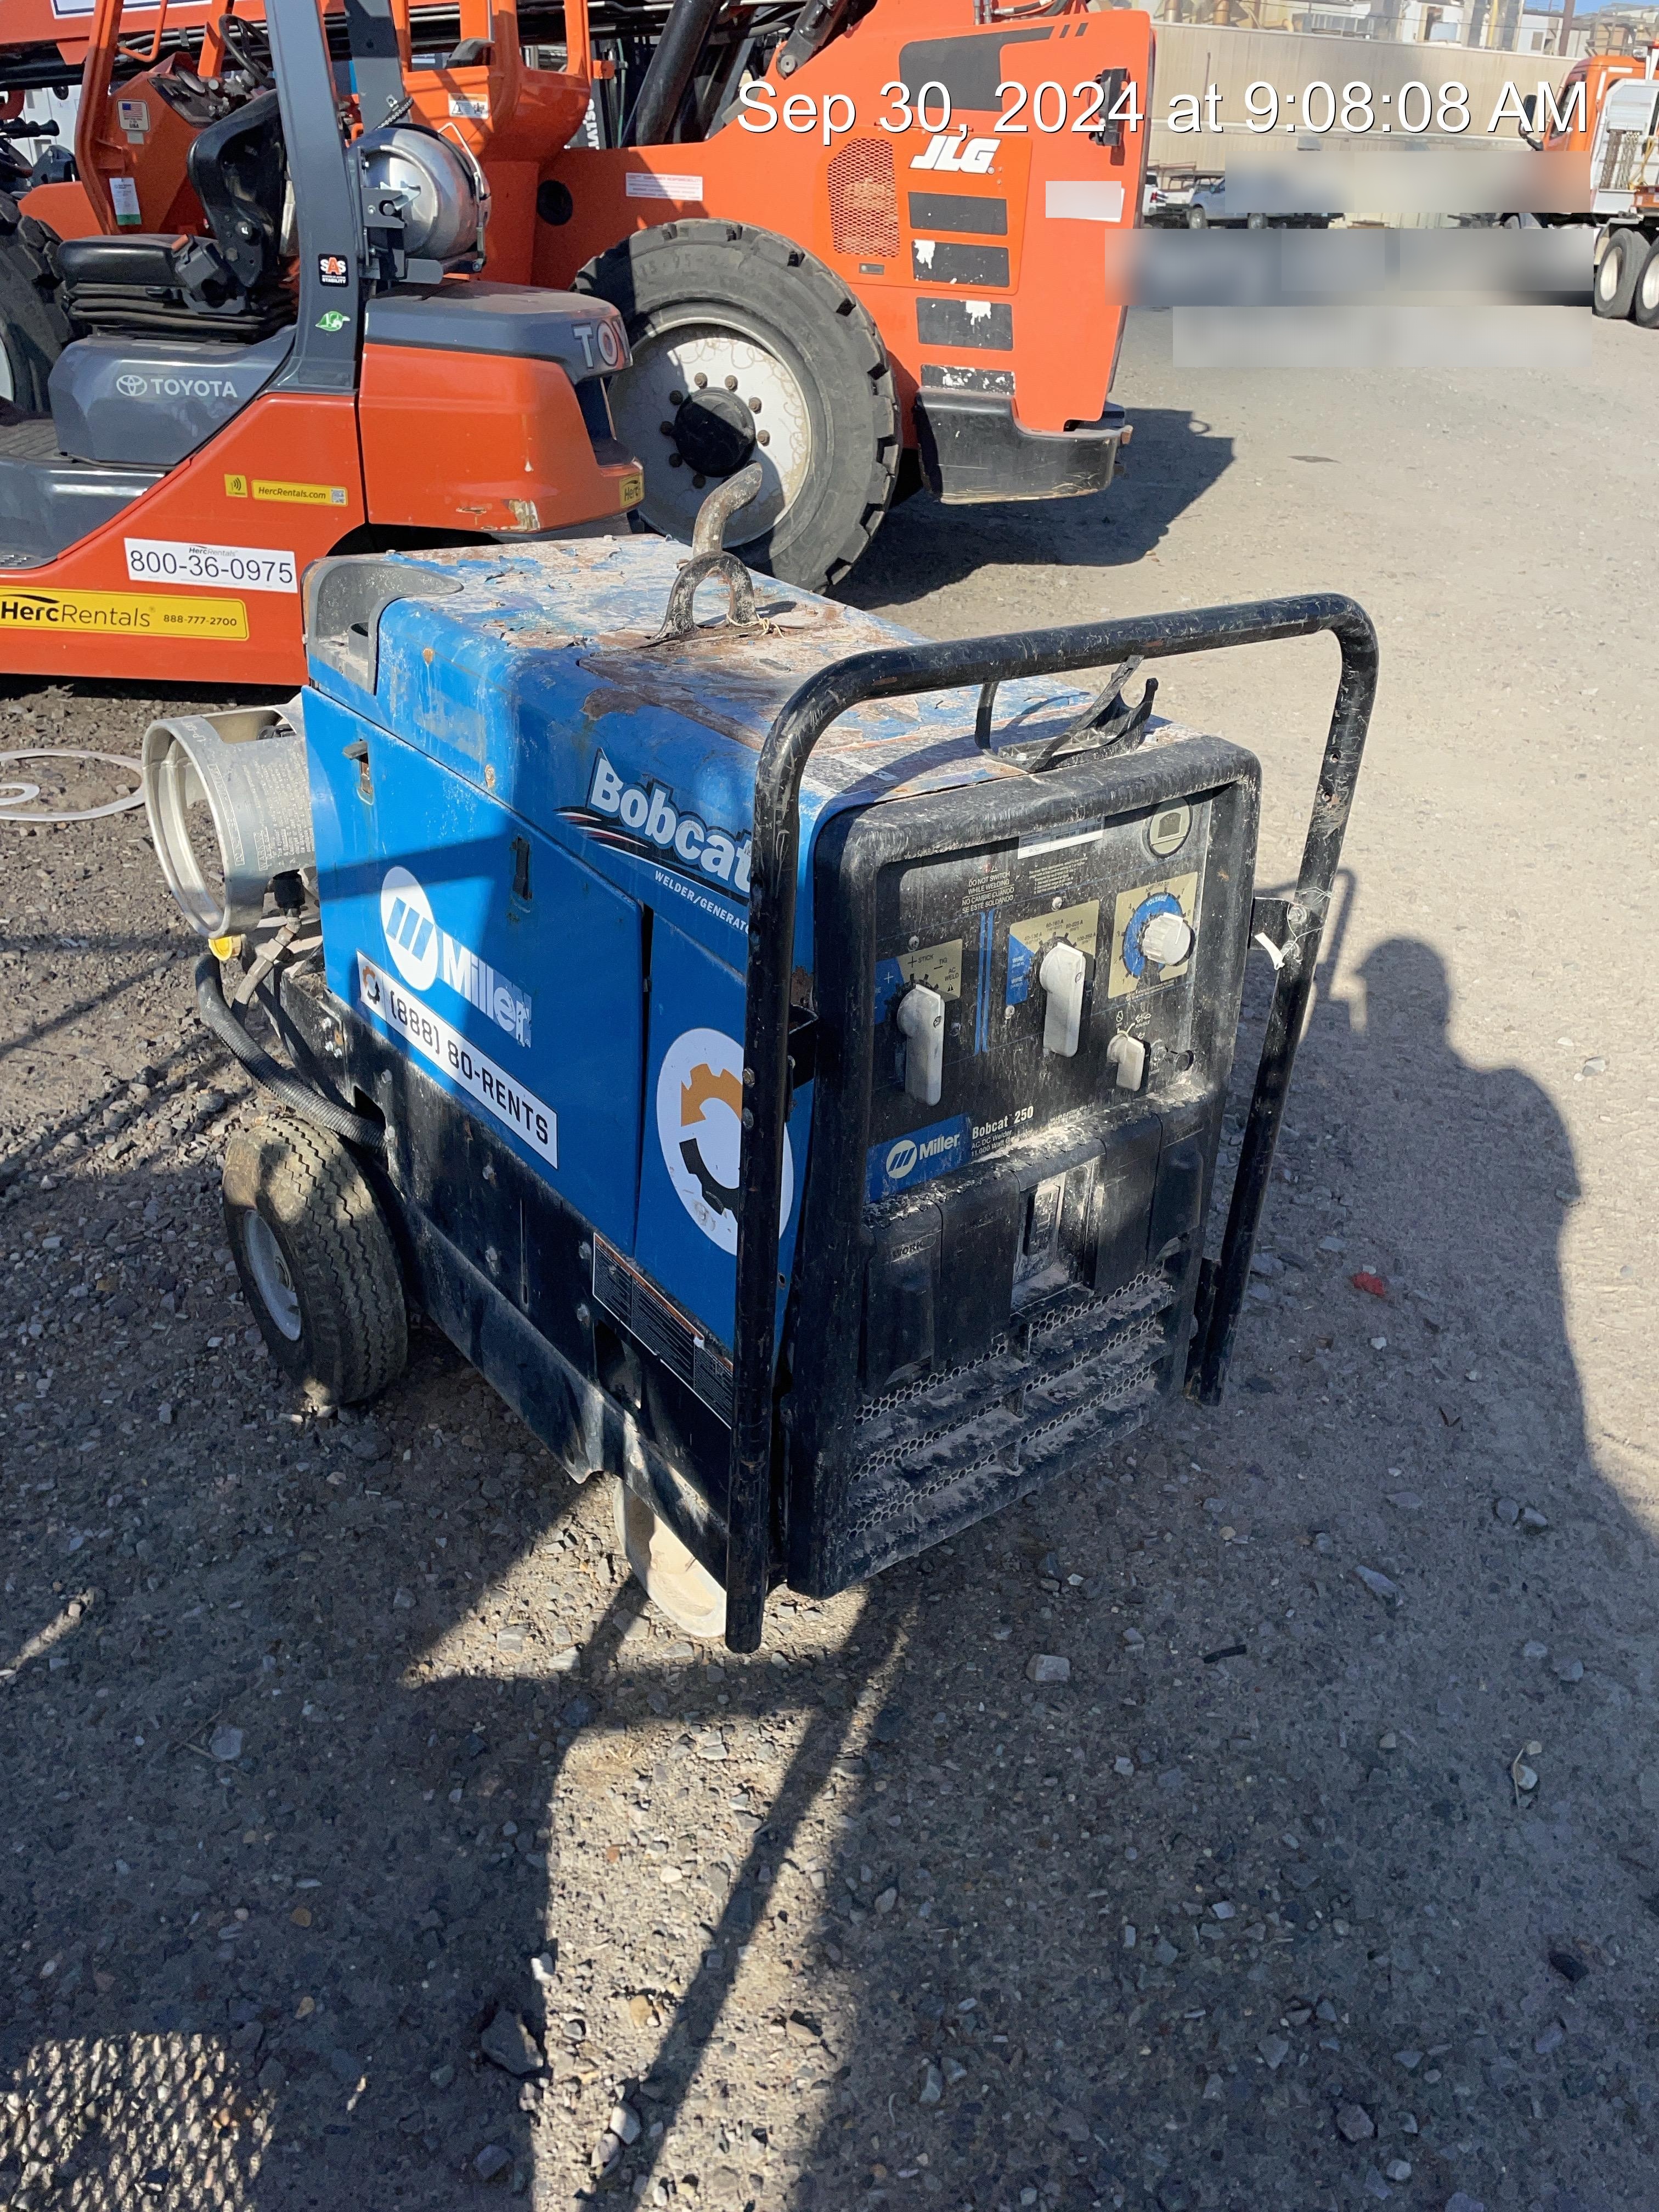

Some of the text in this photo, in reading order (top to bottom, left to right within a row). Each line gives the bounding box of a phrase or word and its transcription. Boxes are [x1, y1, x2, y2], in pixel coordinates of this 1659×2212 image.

[909, 134, 1002, 174] JLG
[320, 257, 347, 275] SAS
[150, 379, 238, 398] TOYOTA
[258, 487, 326, 499] HercRentals.com
[189, 547, 236, 557] HercRentals
[131, 550, 293, 583] 800-36-0975
[1, 601, 151, 627] HercRentals
[163, 614, 237, 626] 888-777-2700
[591, 758, 752, 893] Bobcat
[968, 871, 1011, 887] DO NOT SWITCH
[968, 879, 1009, 895] WHILE WELDING
[992, 887, 1014, 898] CUANDO
[985, 895, 1014, 907] SOLDANDO
[1146, 895, 1167, 907] VOLTAGE
[918, 953, 934, 963] STICK
[442, 931, 531, 1044] Miller
[391, 990, 549, 1146] (888) 80-RENTS
[972, 1115, 1009, 1140] Bobcat
[1014, 1105, 1034, 1124] 250
[991, 1129, 1013, 1143] Welder
[919, 1133, 960, 1160] Miller
[991, 1139, 1005, 1150] Watt
